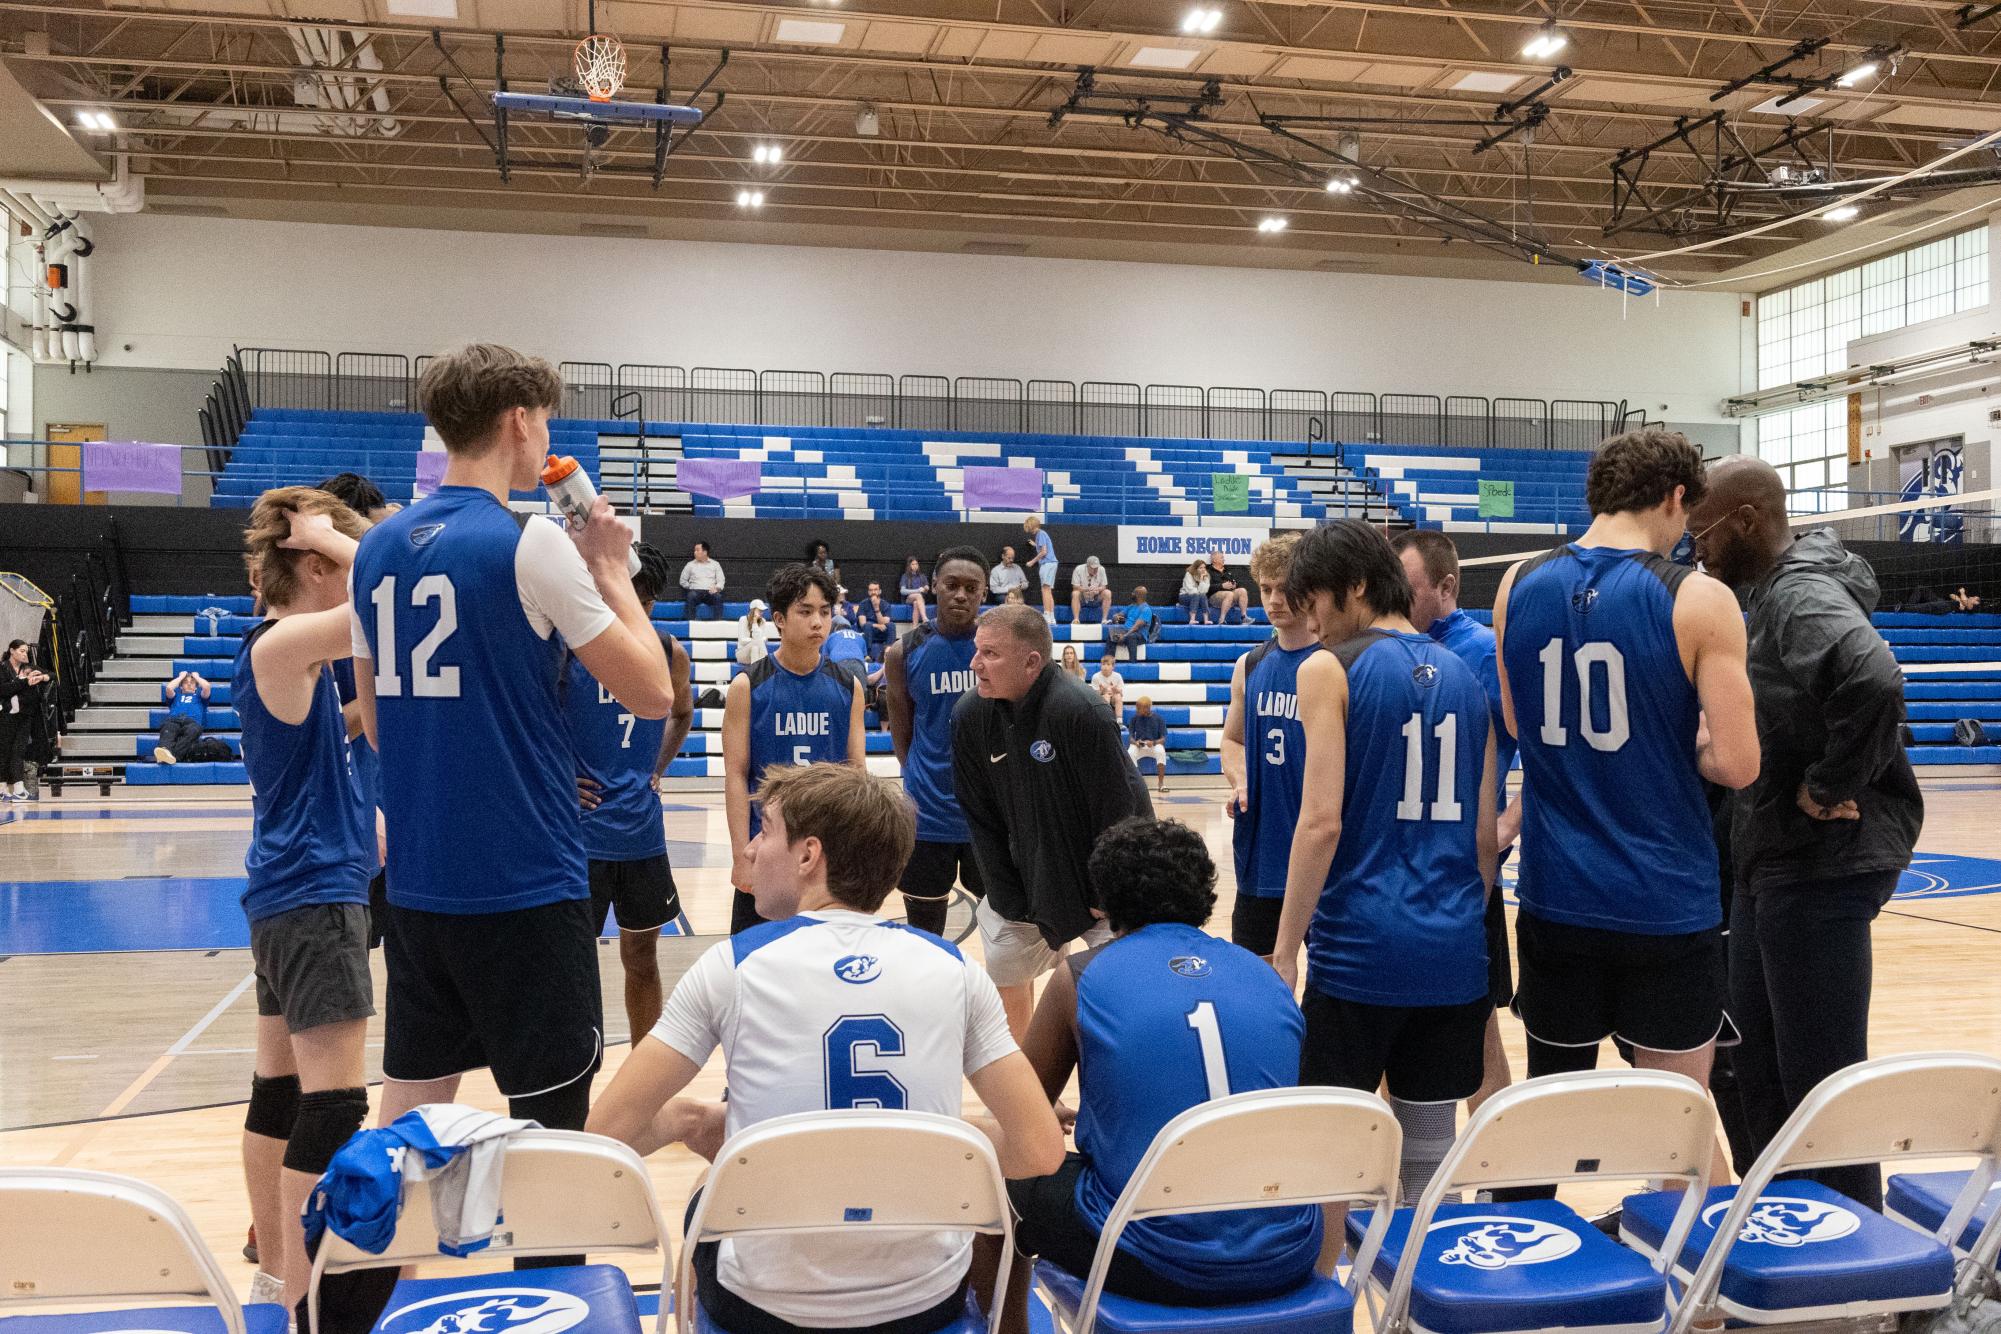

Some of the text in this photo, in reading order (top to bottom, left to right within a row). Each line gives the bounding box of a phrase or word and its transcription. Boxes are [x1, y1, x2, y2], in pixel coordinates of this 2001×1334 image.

[1136, 536, 1252, 555] HOME SECTION
[371, 573, 461, 697] 12
[180, 695, 193, 704] 12
[1539, 637, 1630, 752] 10
[618, 713, 636, 749] 7
[775, 712, 830, 736] LADUE
[793, 745, 813, 769] 5
[1265, 728, 1286, 766] 3
[1396, 712, 1462, 821] 11
[823, 1013, 908, 1110] 6
[1186, 1001, 1231, 1101] 1
